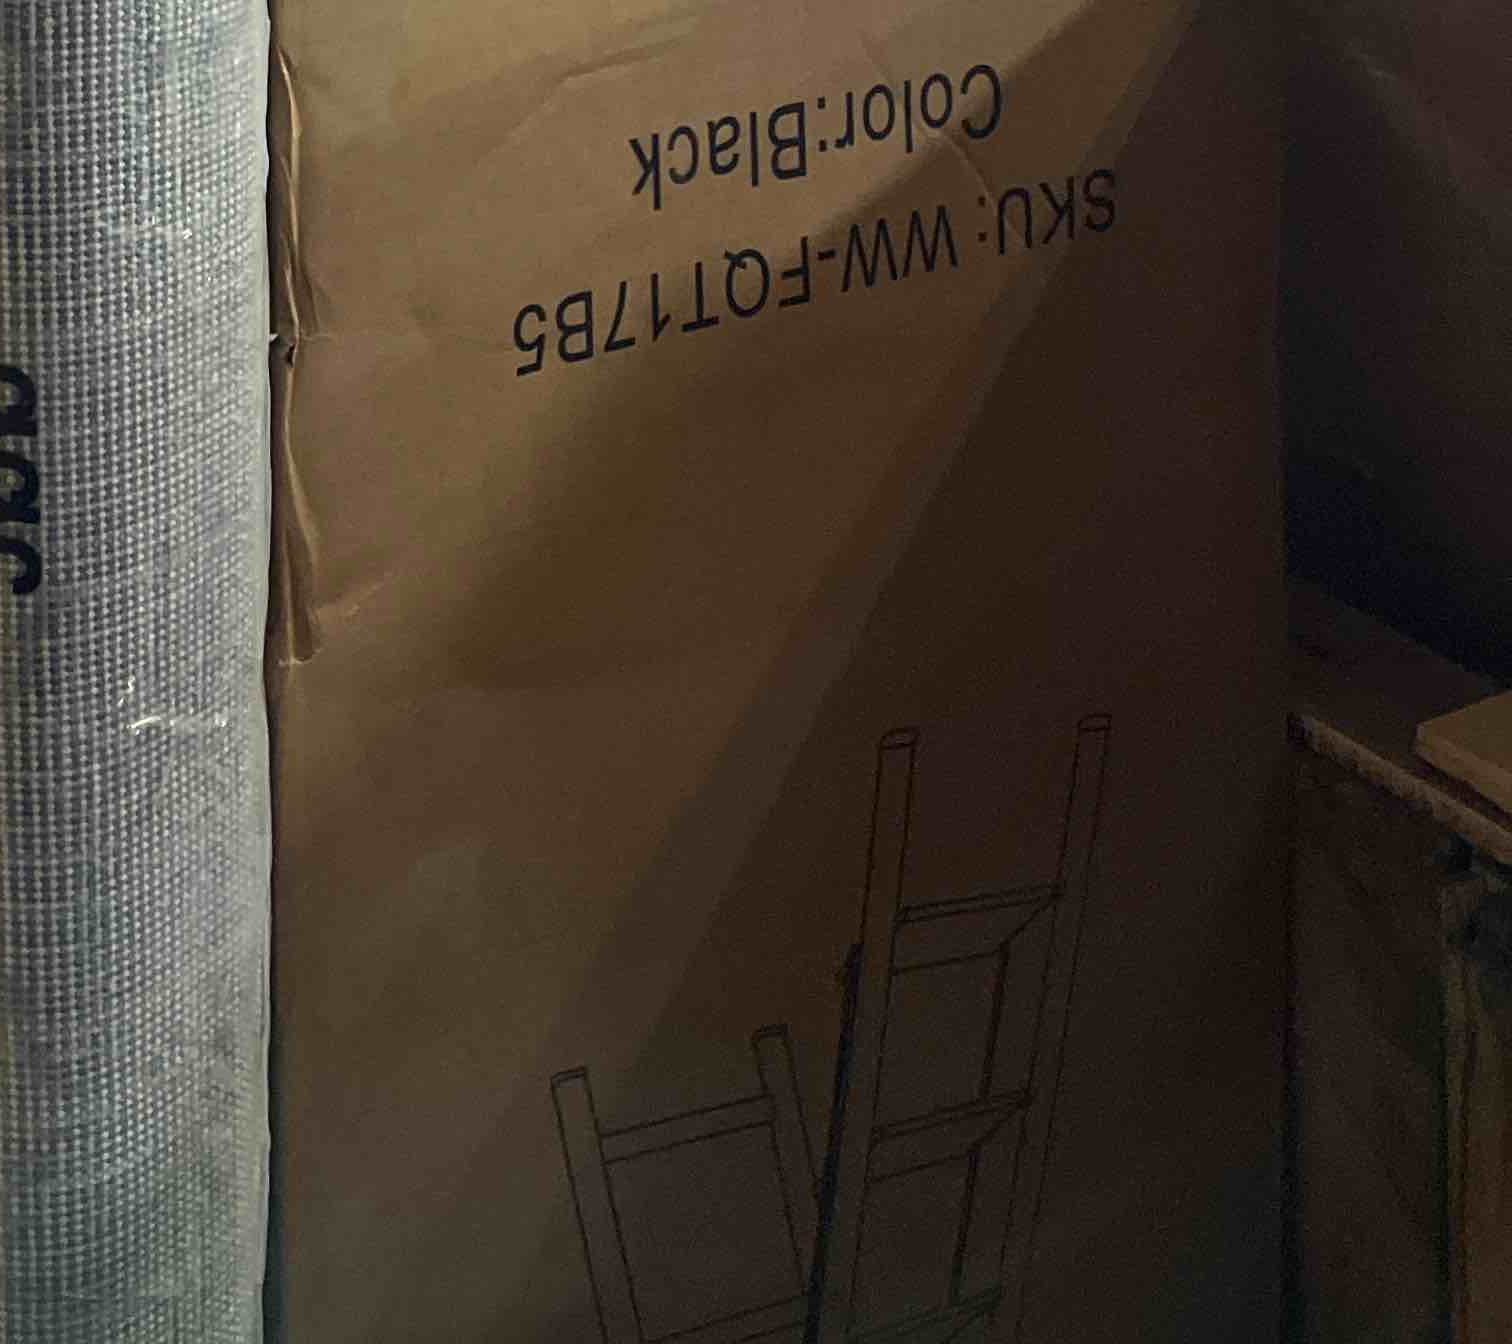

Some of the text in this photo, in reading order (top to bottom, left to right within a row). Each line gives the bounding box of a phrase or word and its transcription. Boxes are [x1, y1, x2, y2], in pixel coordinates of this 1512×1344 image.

[629, 64, 1003, 211] Color:Black
[513, 169, 1118, 377] SKU: WW-FQT17B5
